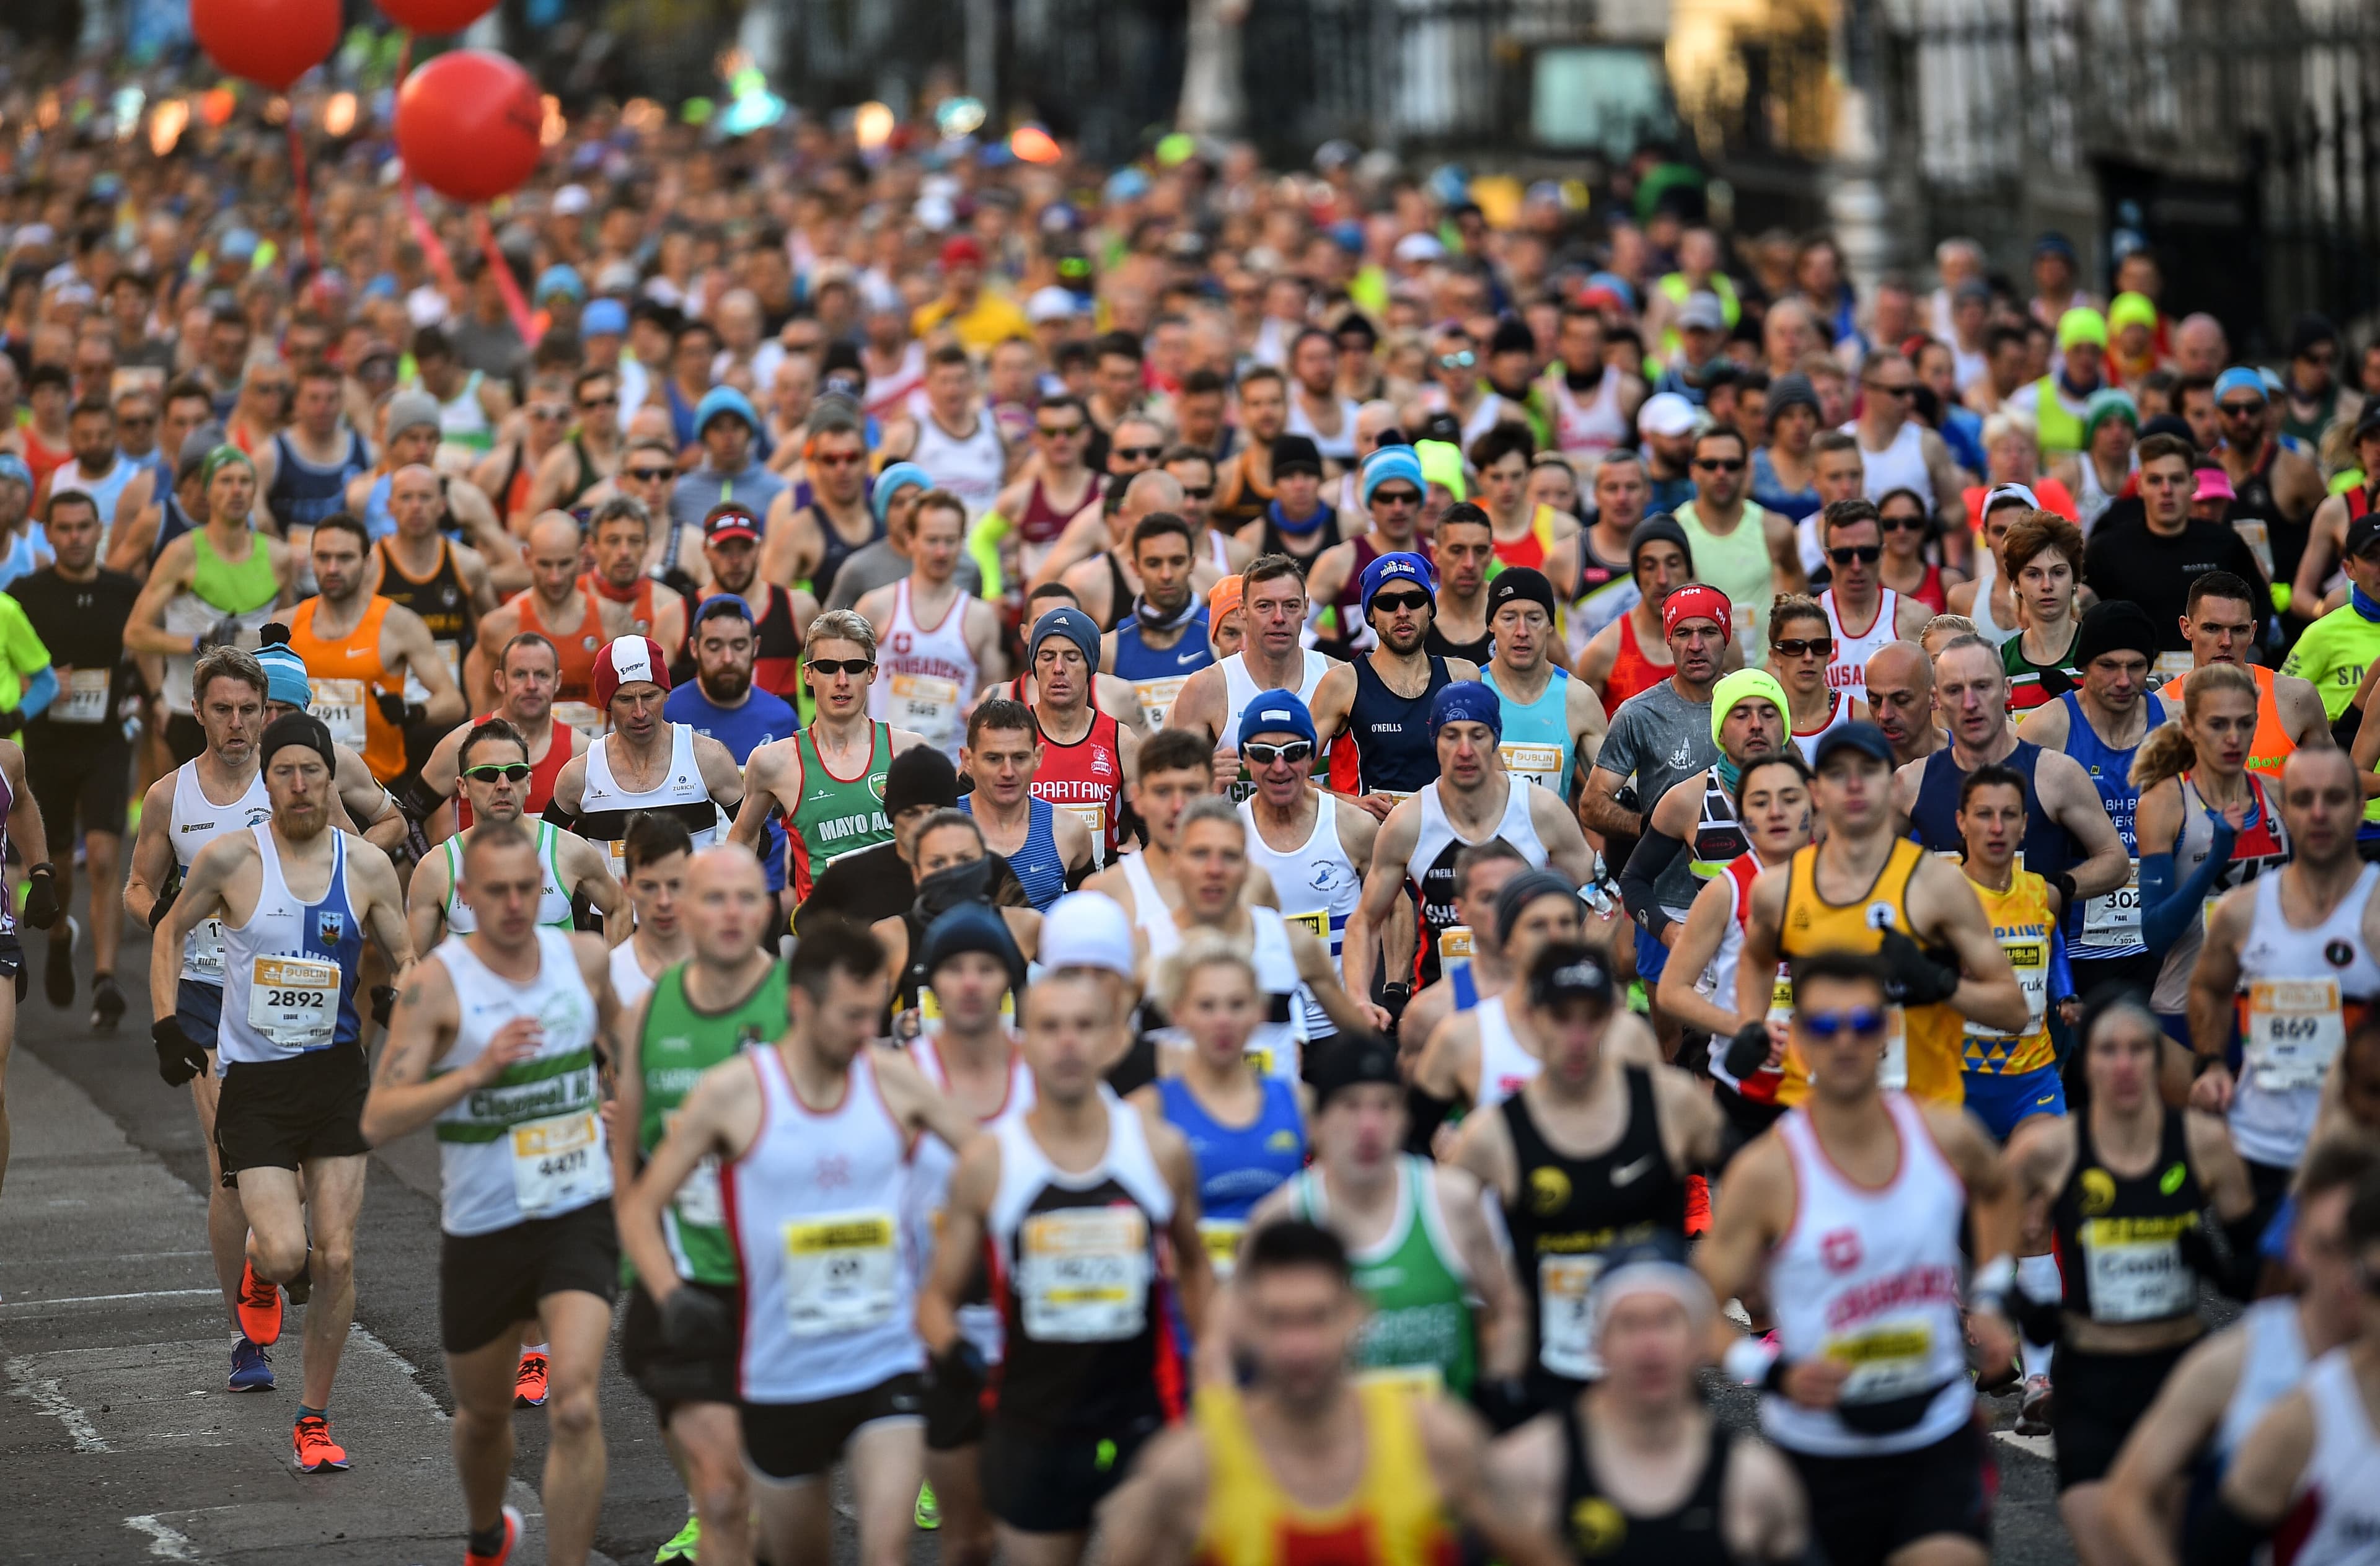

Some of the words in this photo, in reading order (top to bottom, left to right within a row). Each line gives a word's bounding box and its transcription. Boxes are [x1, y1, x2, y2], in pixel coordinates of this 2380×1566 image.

[1371, 723, 1402, 732] O'NEILLS
[1517, 752, 1553, 762] DUBLIN
[1027, 781, 1113, 802] PARTANS
[818, 814, 868, 842] MAYO
[2004, 948, 2038, 959] UBLIN
[286, 967, 327, 979] DUBLIN
[268, 990, 324, 1008] 2892
[2270, 1017, 2318, 1040] 869
